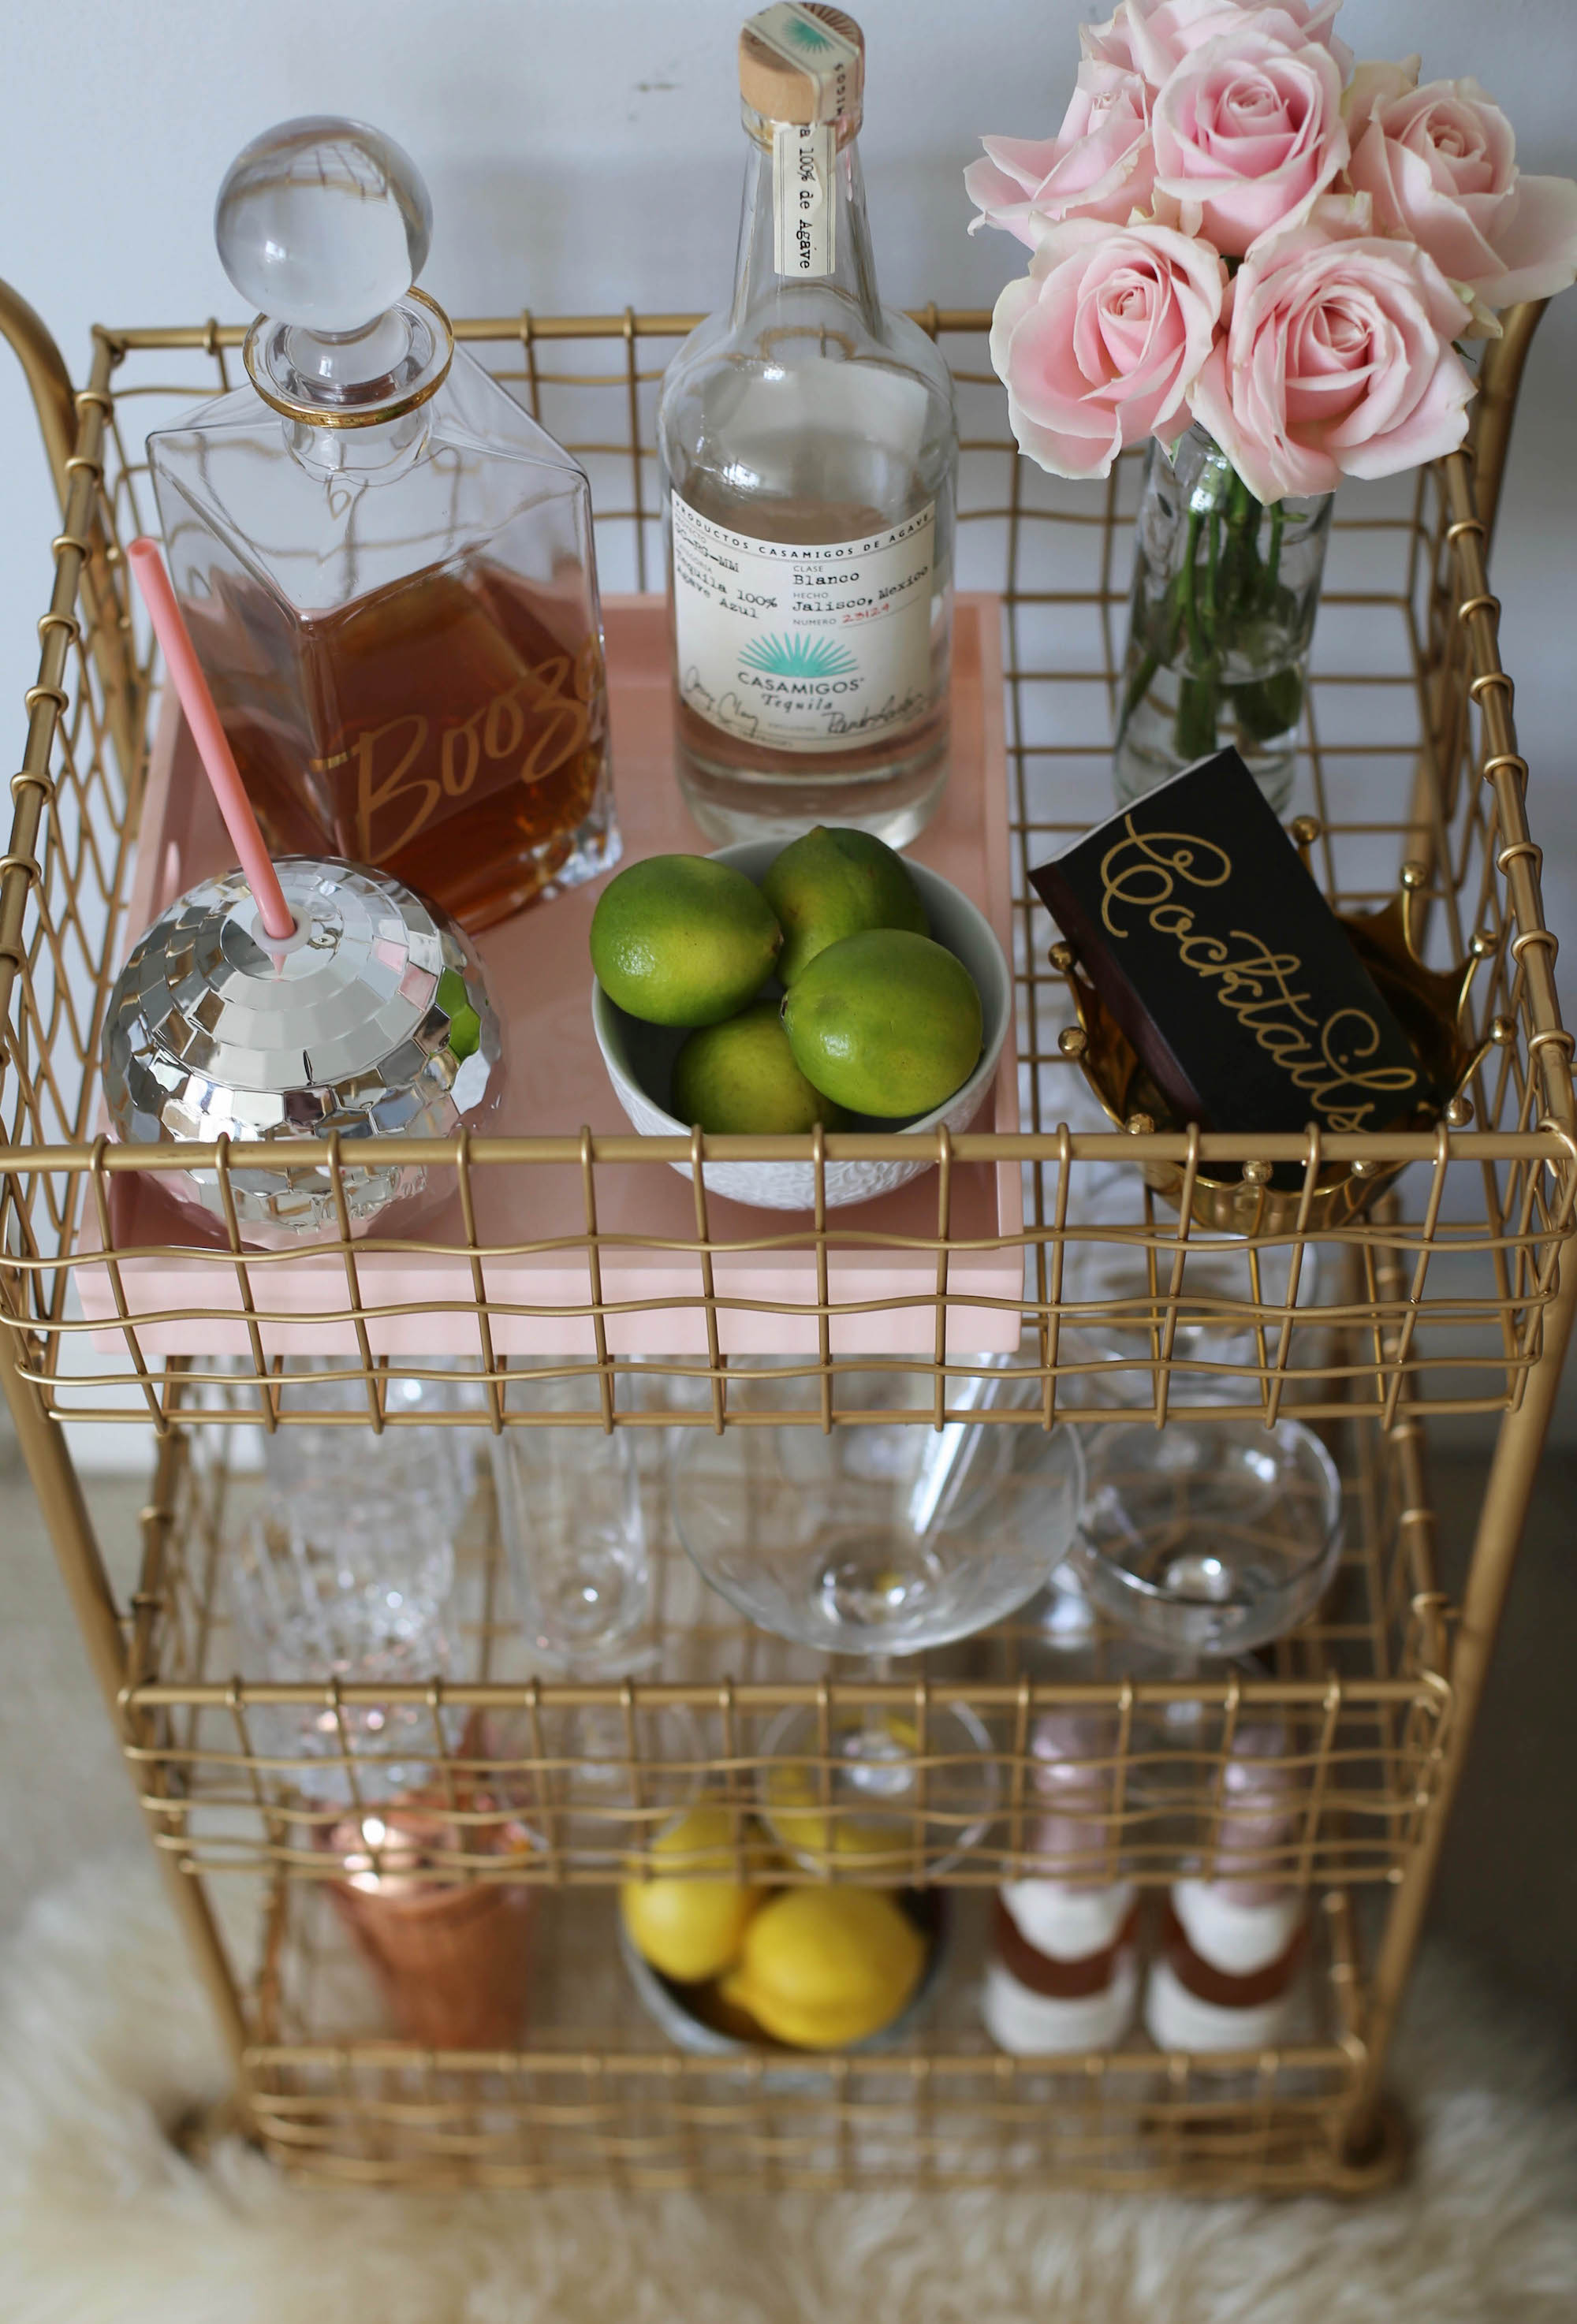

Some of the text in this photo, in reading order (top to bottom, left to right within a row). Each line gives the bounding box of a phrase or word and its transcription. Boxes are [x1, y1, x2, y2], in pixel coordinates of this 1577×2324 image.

[797, 147, 815, 181] 100%
[800, 190, 814, 210] de
[676, 501, 929, 559] PRODUCTOS CASAMIGOS DE AGAVE
[793, 572, 859, 586] Blanco
[719, 598, 759, 619] Azul
[737, 590, 778, 609] 100%
[792, 598, 874, 612] Jalisco,
[738, 672, 859, 695] CASAMIGOS
[762, 693, 833, 713] Tequila
[1100, 813, 1418, 1134] Cocktails
